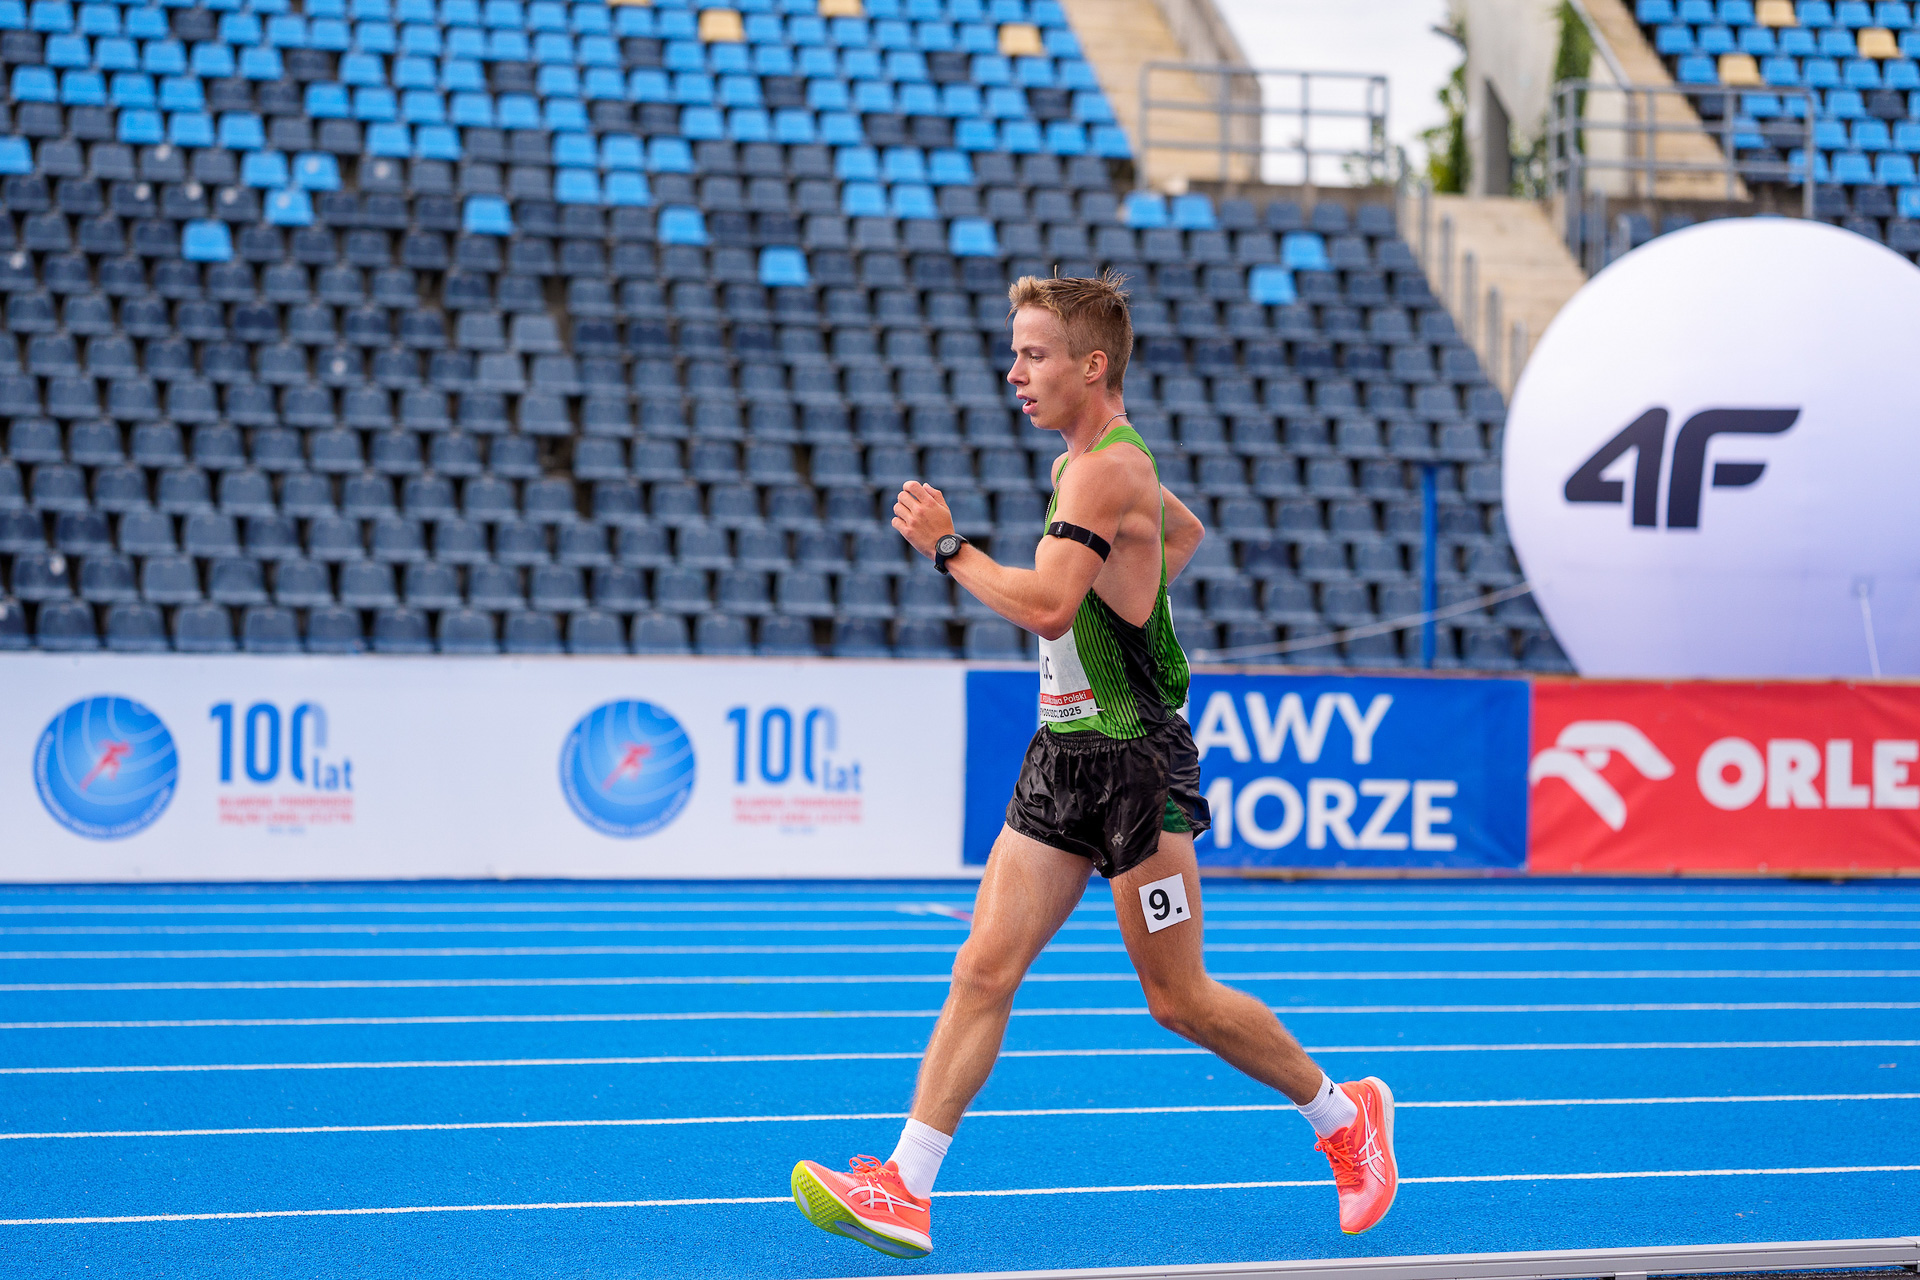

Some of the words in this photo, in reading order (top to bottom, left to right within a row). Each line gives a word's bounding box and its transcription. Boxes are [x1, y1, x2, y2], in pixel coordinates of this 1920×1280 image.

[1563, 407, 1802, 529] 4F
[1059, 706, 1082, 718] 2025
[1063, 692, 1087, 704] Polski
[209, 702, 328, 784] 100
[725, 705, 838, 785] 100
[1187, 689, 1394, 764] AWY
[313, 756, 355, 791] lat
[823, 758, 862, 792] lat
[1696, 736, 1920, 811] ORLE
[1148, 888, 1183, 921] 9.
